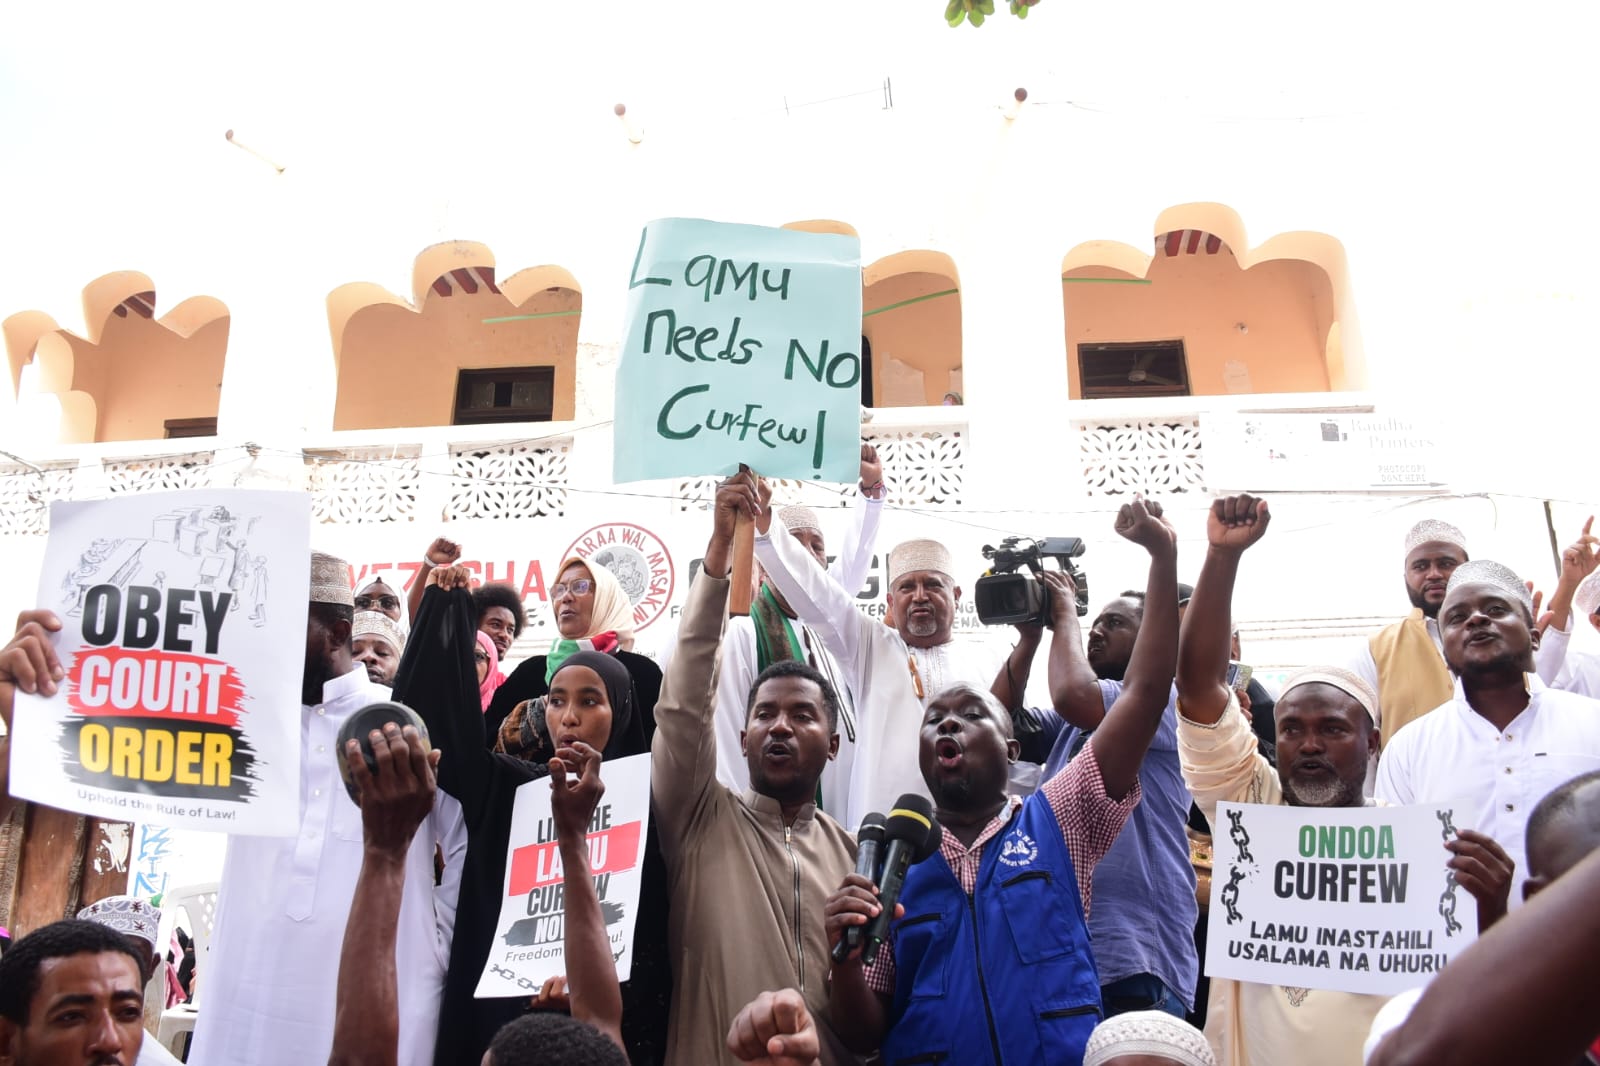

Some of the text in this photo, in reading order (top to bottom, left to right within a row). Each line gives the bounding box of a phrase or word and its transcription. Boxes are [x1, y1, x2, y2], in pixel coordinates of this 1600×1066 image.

[575, 527, 617, 559] ARAA
[622, 527, 647, 552] WAL
[633, 552, 668, 625] MASAKIN
[81, 584, 233, 654] OBEY
[79, 655, 228, 715] COURT
[78, 723, 234, 787] ORDER
[77, 789, 236, 820] Uphold the Rule of Law!
[588, 804, 612, 833] HE
[535, 834, 608, 883] LAU
[1298, 825, 1395, 859] ONDOA
[527, 872, 611, 916] CURW
[1273, 861, 1409, 903] CURFEW
[1250, 921, 1432, 950] LAMU INASTAHILI
[505, 947, 563, 962] Freedom
[1228, 940, 1447, 973] USALAMA NA UHURU
